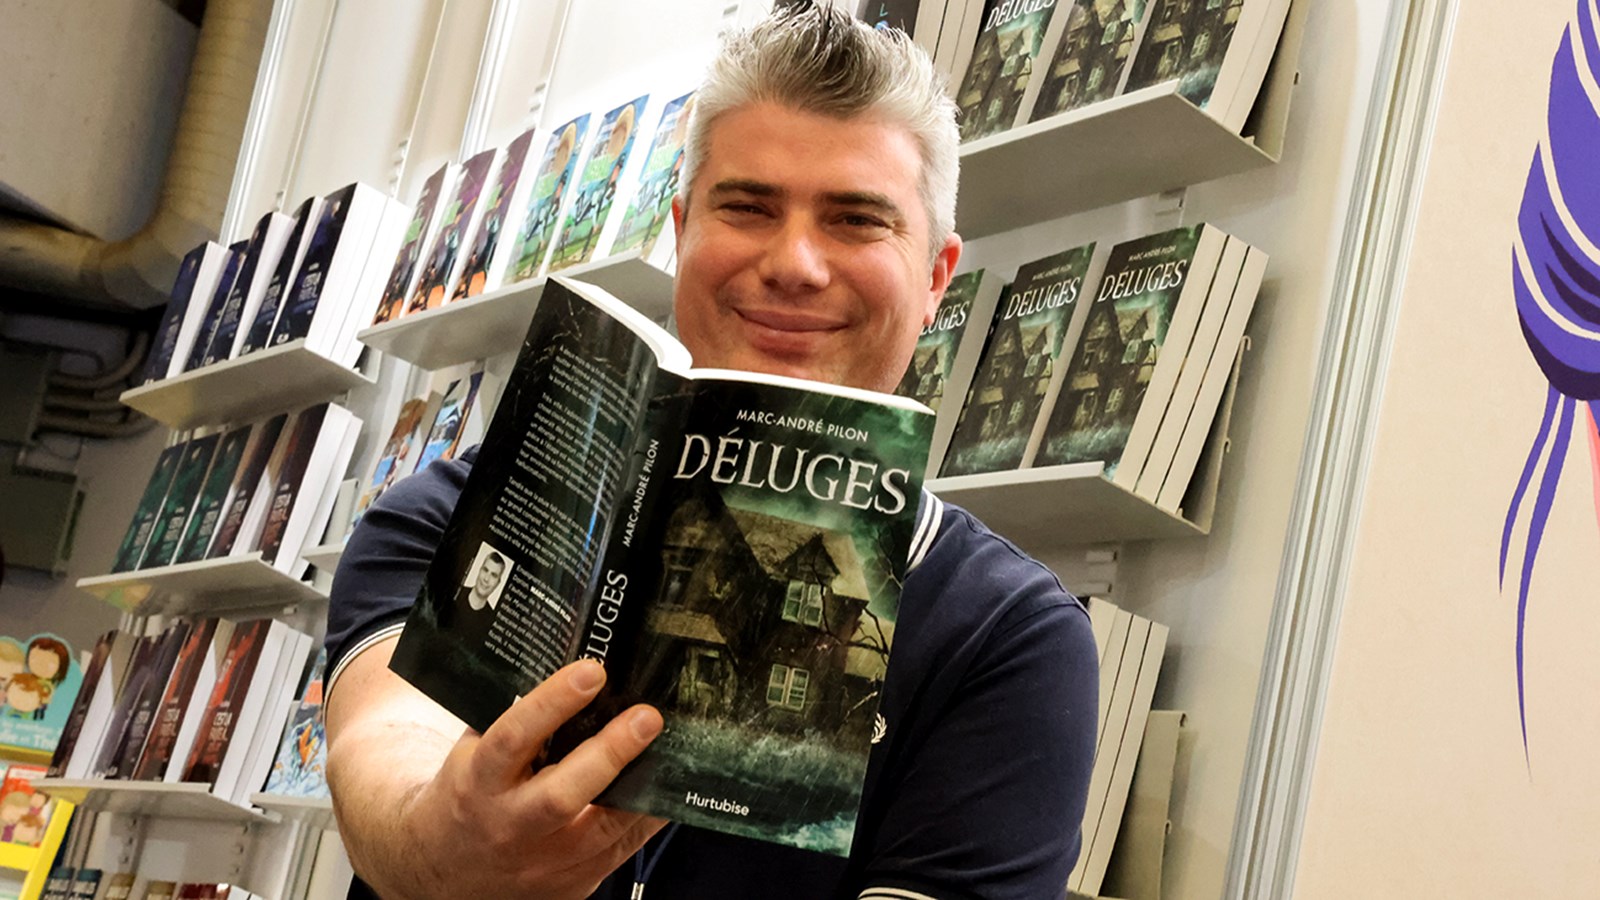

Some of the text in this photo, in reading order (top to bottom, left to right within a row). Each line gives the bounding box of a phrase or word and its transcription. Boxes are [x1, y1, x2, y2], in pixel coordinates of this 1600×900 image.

[1003, 276, 1081, 321] DÉLUGES
[1097, 259, 1188, 303] DÉLUGES
[736, 409, 869, 443] MARC-ANDRÉ PILON
[622, 439, 660, 548] MARC-ANDRÉ PILON
[673, 426, 911, 516] DÉLUGES
[579, 569, 628, 666] LUGES
[685, 791, 750, 816] Hurtubise
